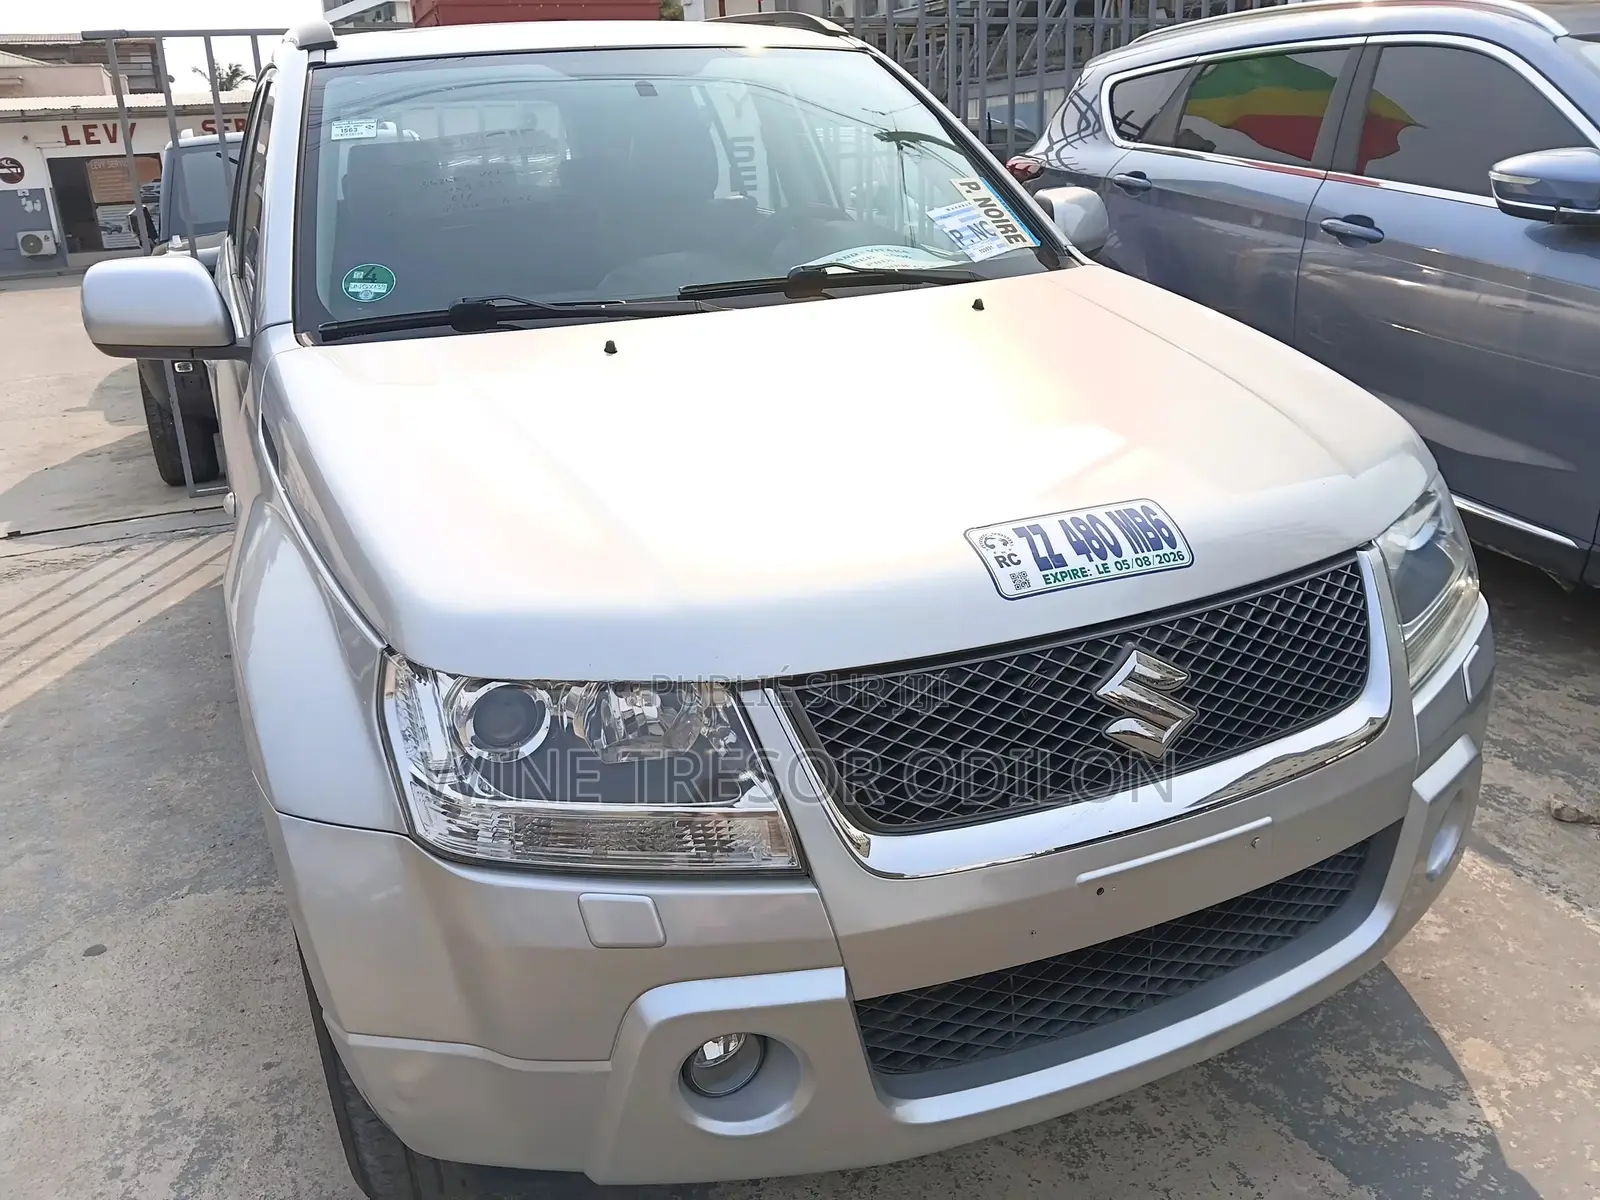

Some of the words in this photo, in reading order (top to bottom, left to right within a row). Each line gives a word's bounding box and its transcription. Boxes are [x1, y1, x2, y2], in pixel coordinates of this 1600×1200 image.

[973, 197, 1027, 245] NOIRE
[1012, 524, 1068, 571] ZZ
[1058, 514, 1122, 562] 480
[1105, 505, 1178, 555] MB6
[994, 552, 1021, 569] RC
[1042, 566, 1092, 586] EXPIRE:
[1096, 561, 1111, 575] LE
[1114, 550, 1185, 572] 05/08/2026
